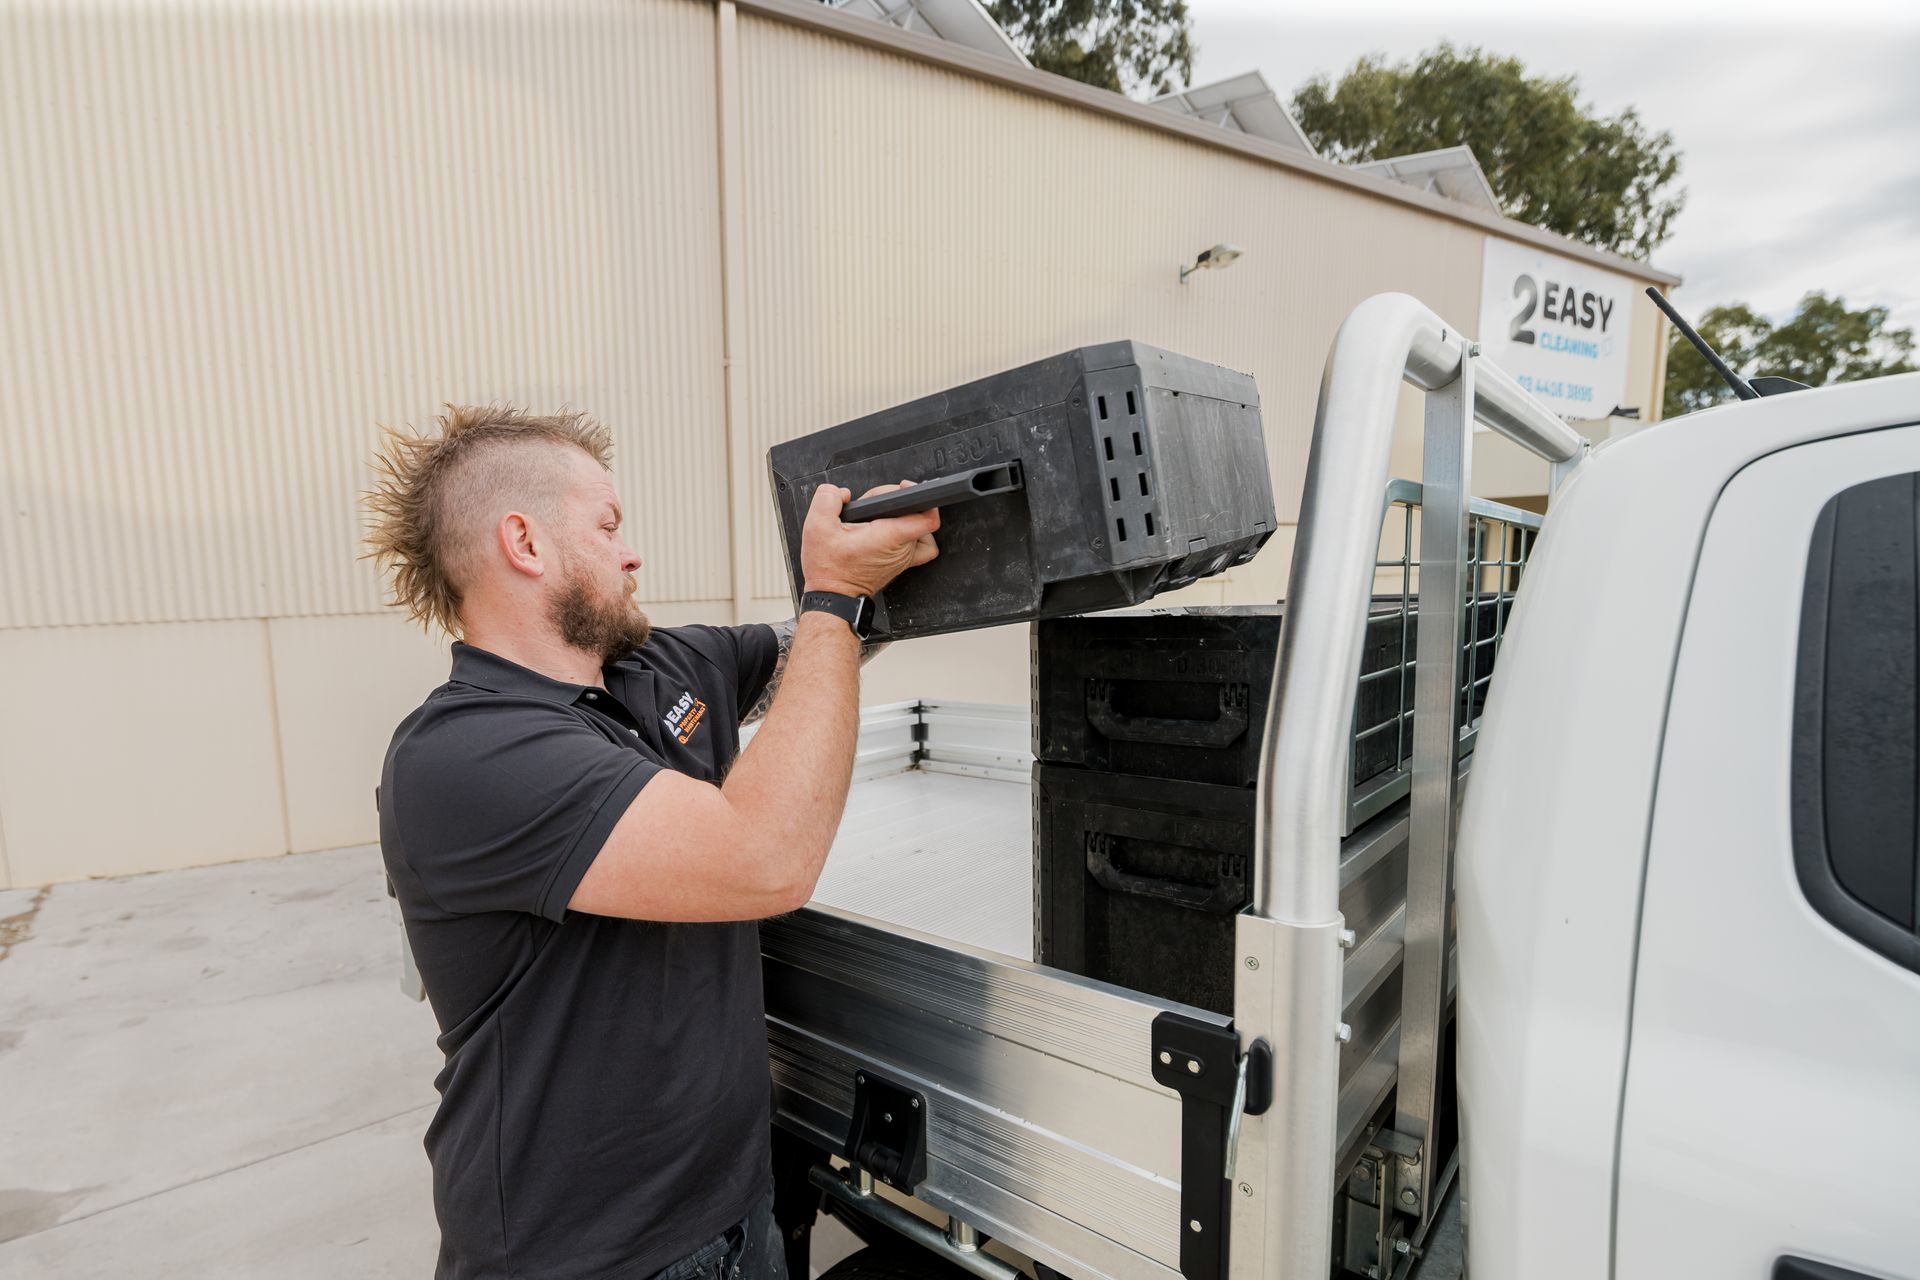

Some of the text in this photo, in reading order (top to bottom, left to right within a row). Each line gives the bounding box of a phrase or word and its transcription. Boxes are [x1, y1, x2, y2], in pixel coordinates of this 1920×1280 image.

[1510, 274, 1613, 345] 2 EASY
[1539, 331, 1599, 359] CLEANING
[666, 691, 694, 724] EASY
